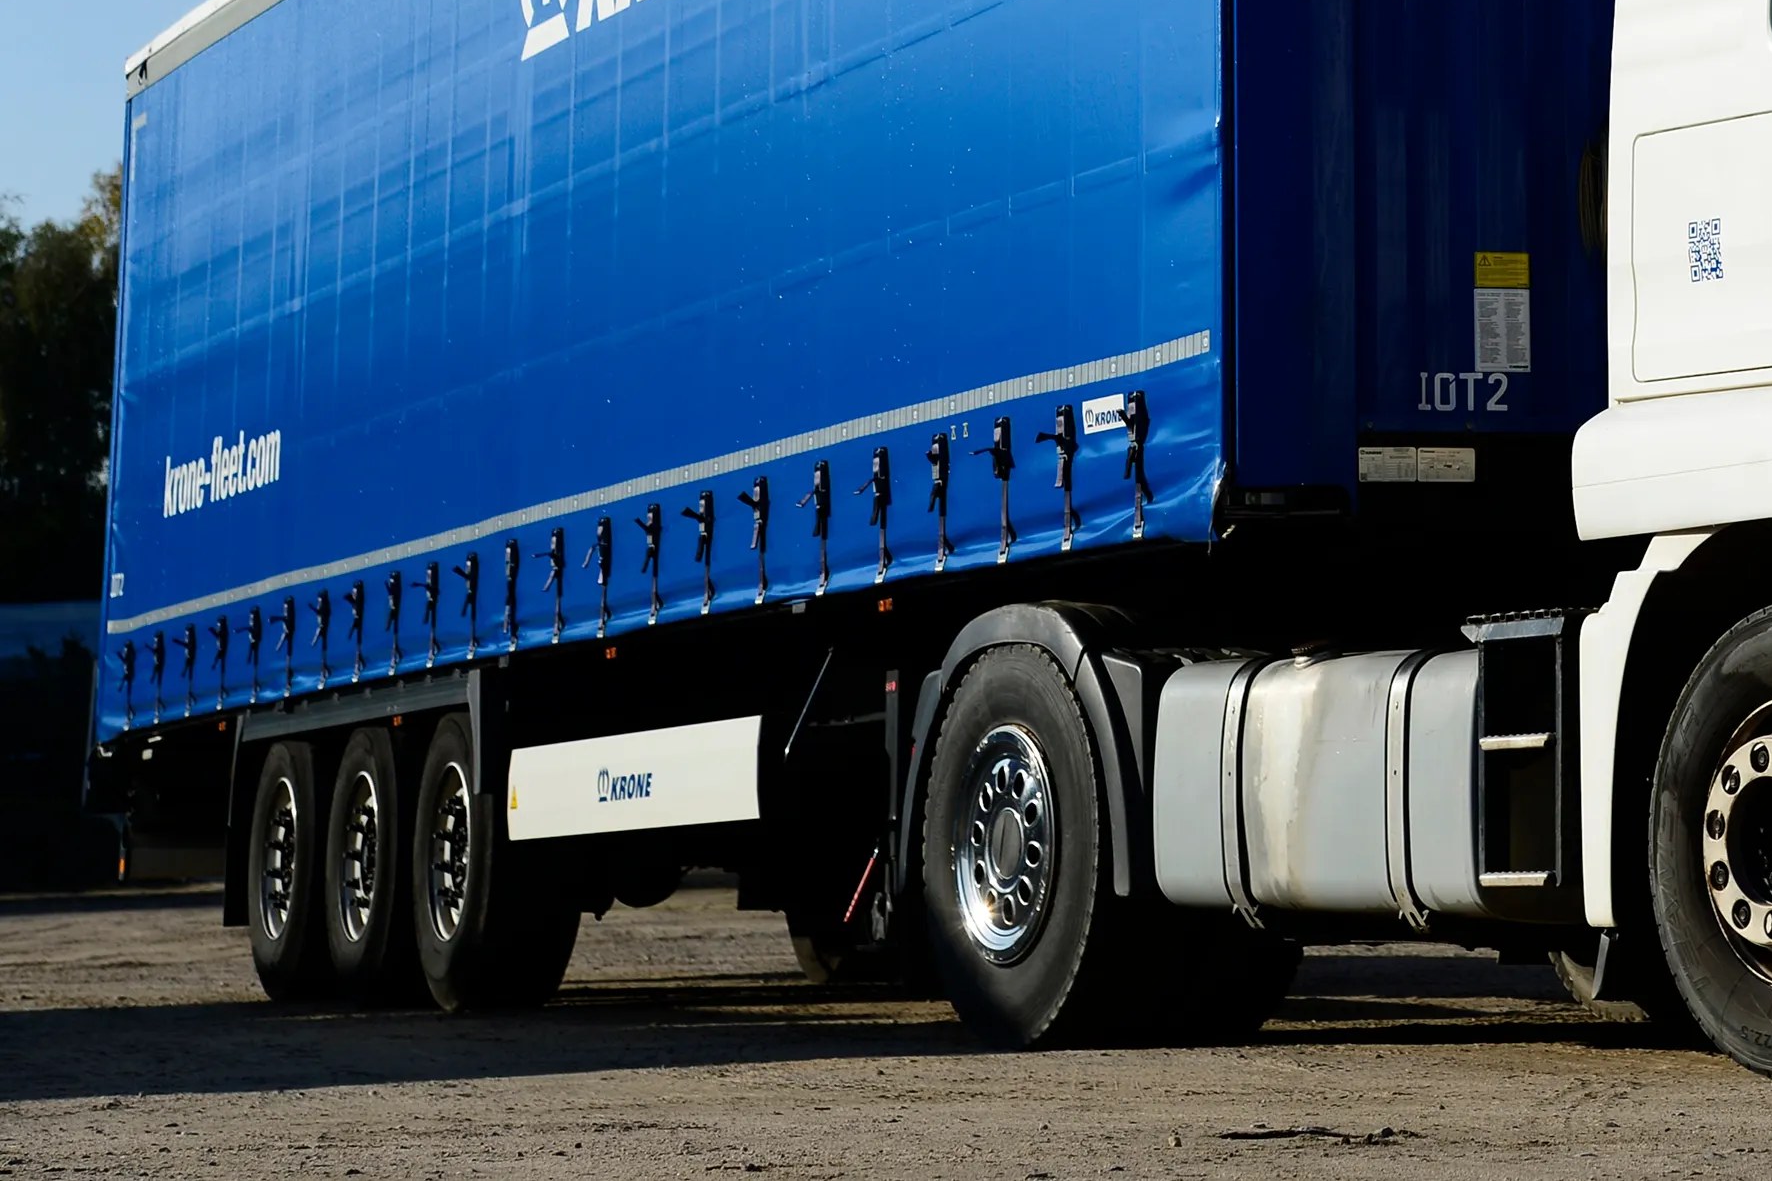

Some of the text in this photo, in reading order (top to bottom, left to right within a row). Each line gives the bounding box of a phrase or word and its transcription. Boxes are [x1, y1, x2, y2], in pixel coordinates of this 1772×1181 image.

[163, 428, 281, 518] krone-fleet.com
[610, 772, 652, 801] KRONE
[1740, 1024, 1772, 1050] 22.5
